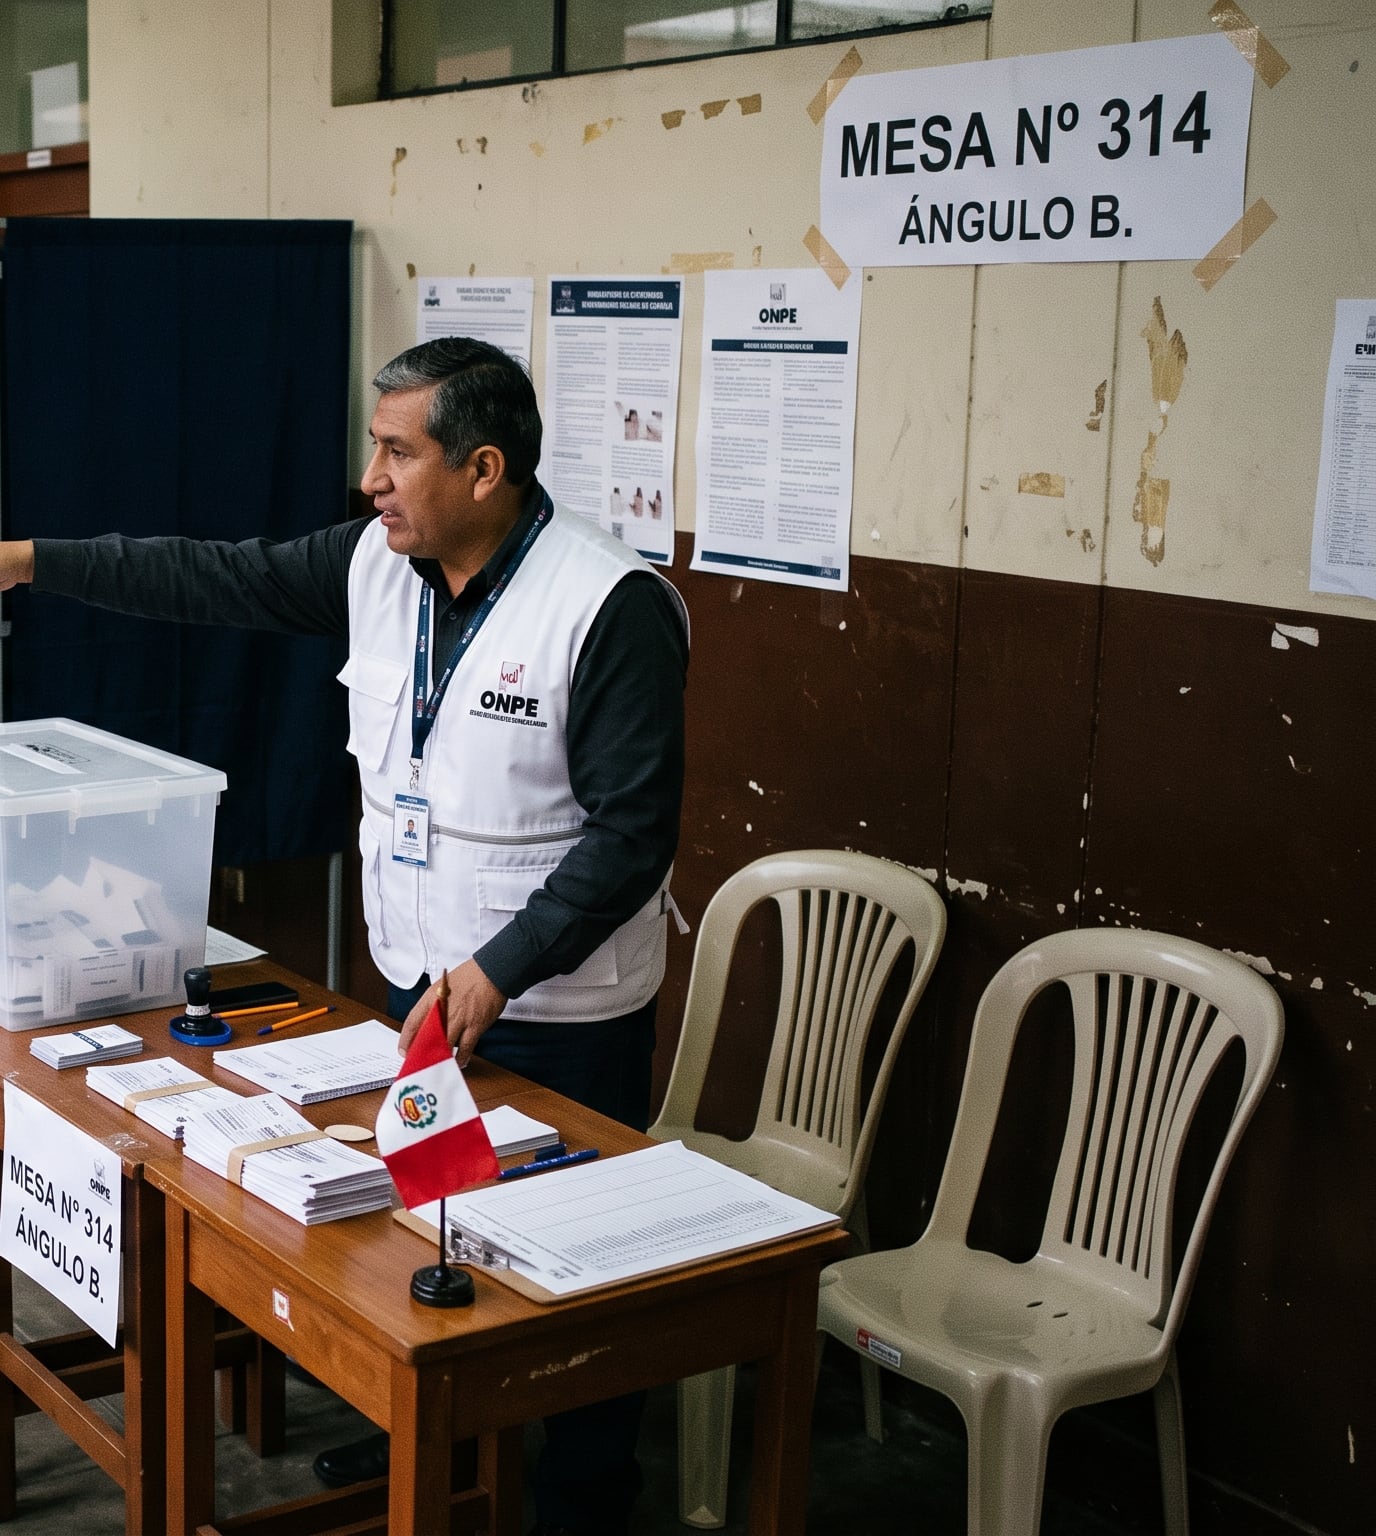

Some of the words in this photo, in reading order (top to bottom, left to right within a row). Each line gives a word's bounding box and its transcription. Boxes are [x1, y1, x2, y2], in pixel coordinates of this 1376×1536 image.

[840, 111, 996, 178] MESA
[1097, 90, 1212, 161] 314
[898, 194, 1075, 245] ÁNGULO
[1090, 194, 1133, 239] B.
[759, 308, 797, 323] ONPE
[480, 690, 539, 718] ONPE
[10, 1155, 56, 1213] MESA
[84, 1207, 114, 1254] 314
[15, 1207, 85, 1285] ÁNGULO
[88, 1265, 105, 1304] B.
